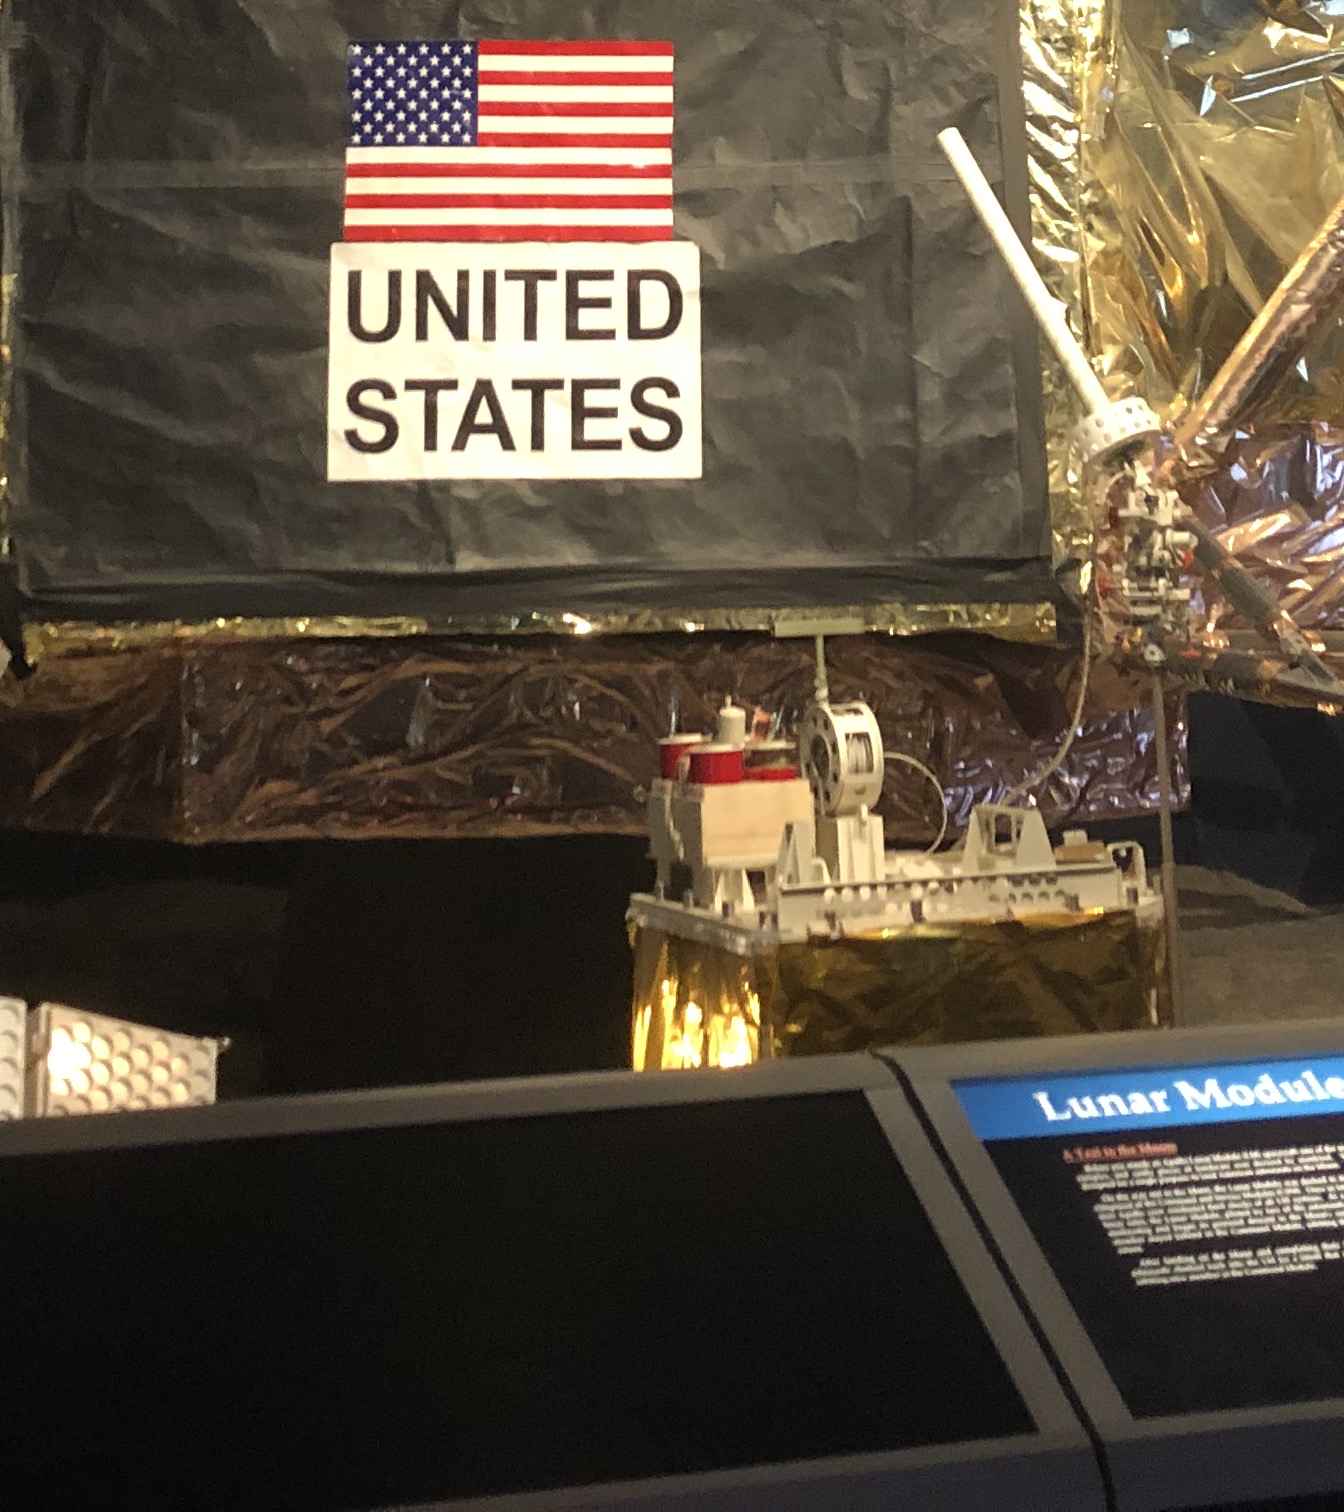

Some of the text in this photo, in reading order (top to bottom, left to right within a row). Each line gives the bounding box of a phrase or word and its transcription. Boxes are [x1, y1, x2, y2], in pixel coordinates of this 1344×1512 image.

[346, 269, 684, 343] UNITED
[344, 376, 684, 453] STATES
[1033, 1090, 1172, 1121] Lunar
